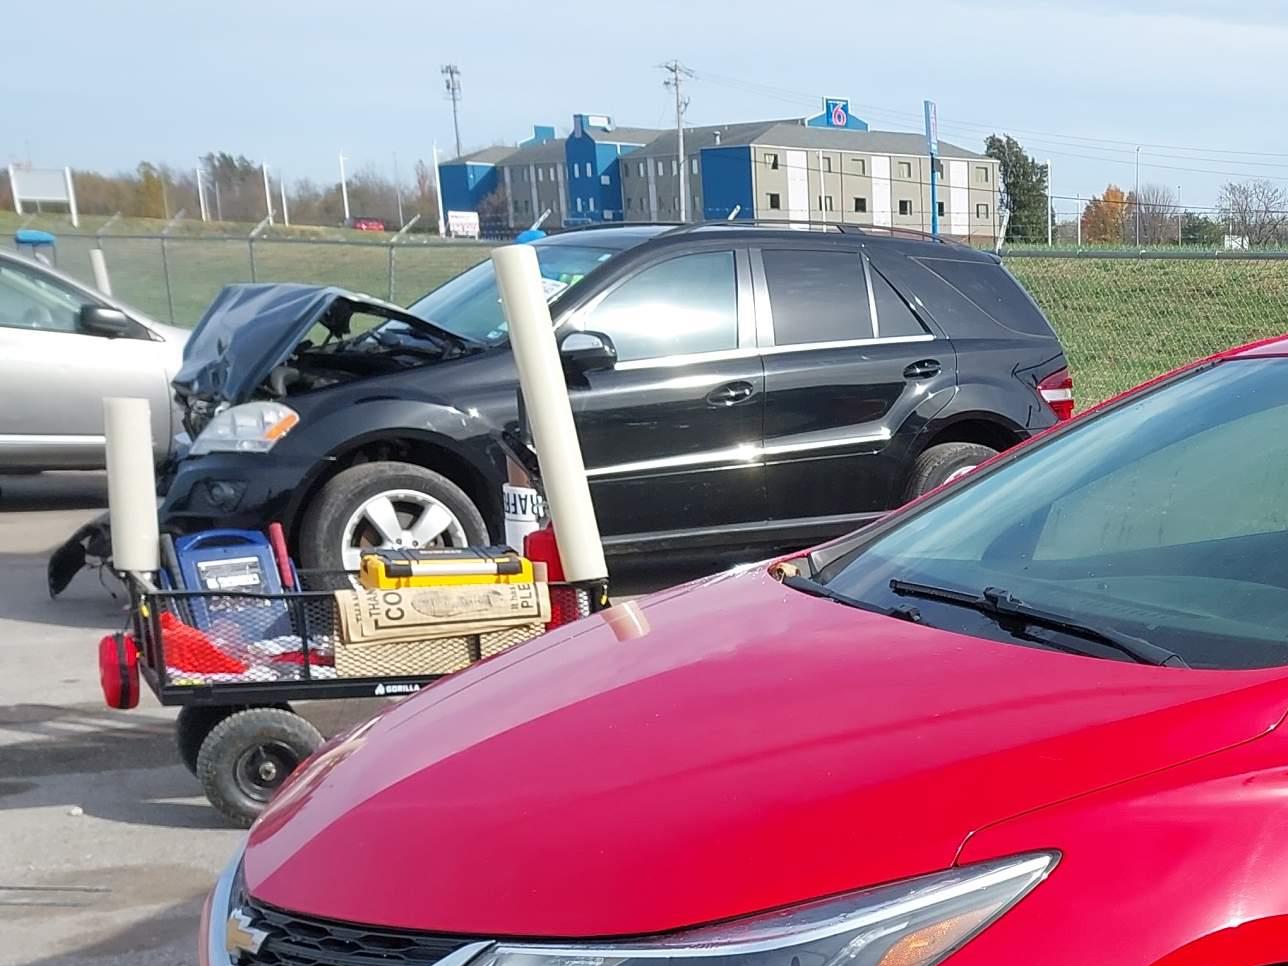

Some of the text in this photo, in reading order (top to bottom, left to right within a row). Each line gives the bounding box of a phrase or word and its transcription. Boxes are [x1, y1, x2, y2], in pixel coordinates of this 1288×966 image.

[832, 103, 847, 127] 6
[383, 592, 404, 620] CO
[386, 685, 420, 693] GORILLA
